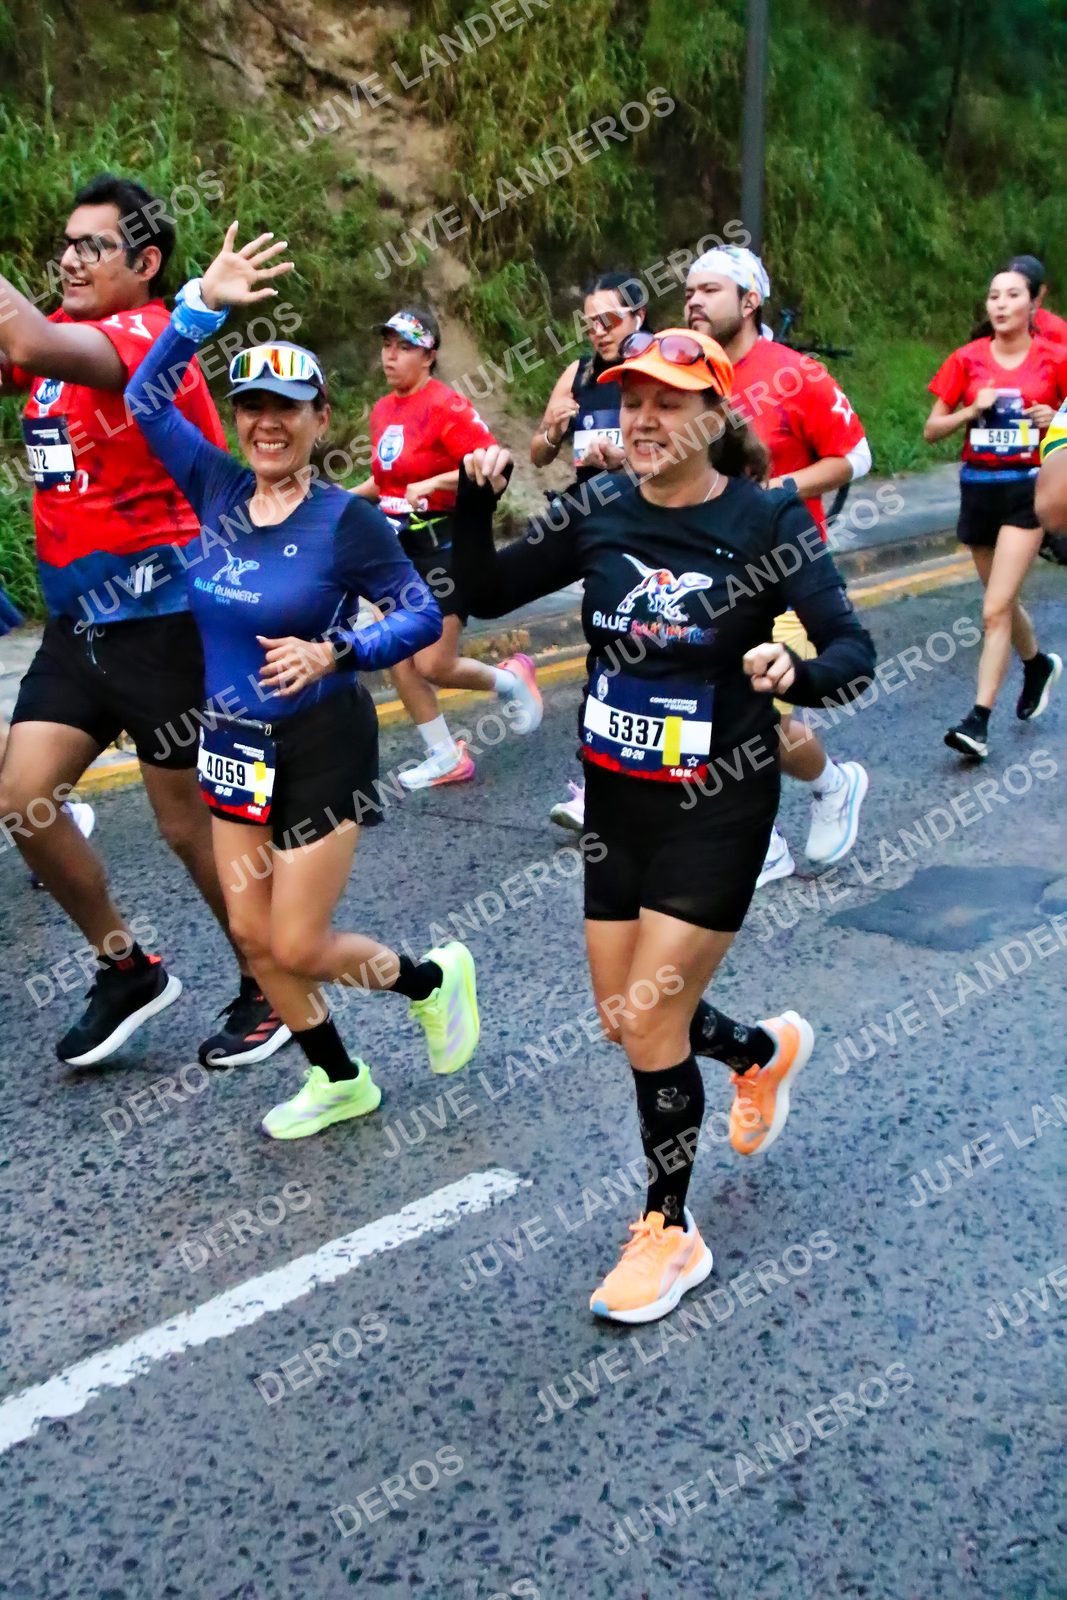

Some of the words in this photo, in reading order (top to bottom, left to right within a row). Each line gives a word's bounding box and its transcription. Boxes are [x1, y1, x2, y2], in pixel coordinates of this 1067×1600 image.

[988, 430, 1017, 444] 5497
[193, 576, 215, 594] BLUE
[214, 584, 263, 604] RUNNERS
[592, 610, 631, 633] BLUE
[608, 710, 664, 748] 5337
[206, 755, 246, 787] 4059
[669, 768, 693, 778] 10K
